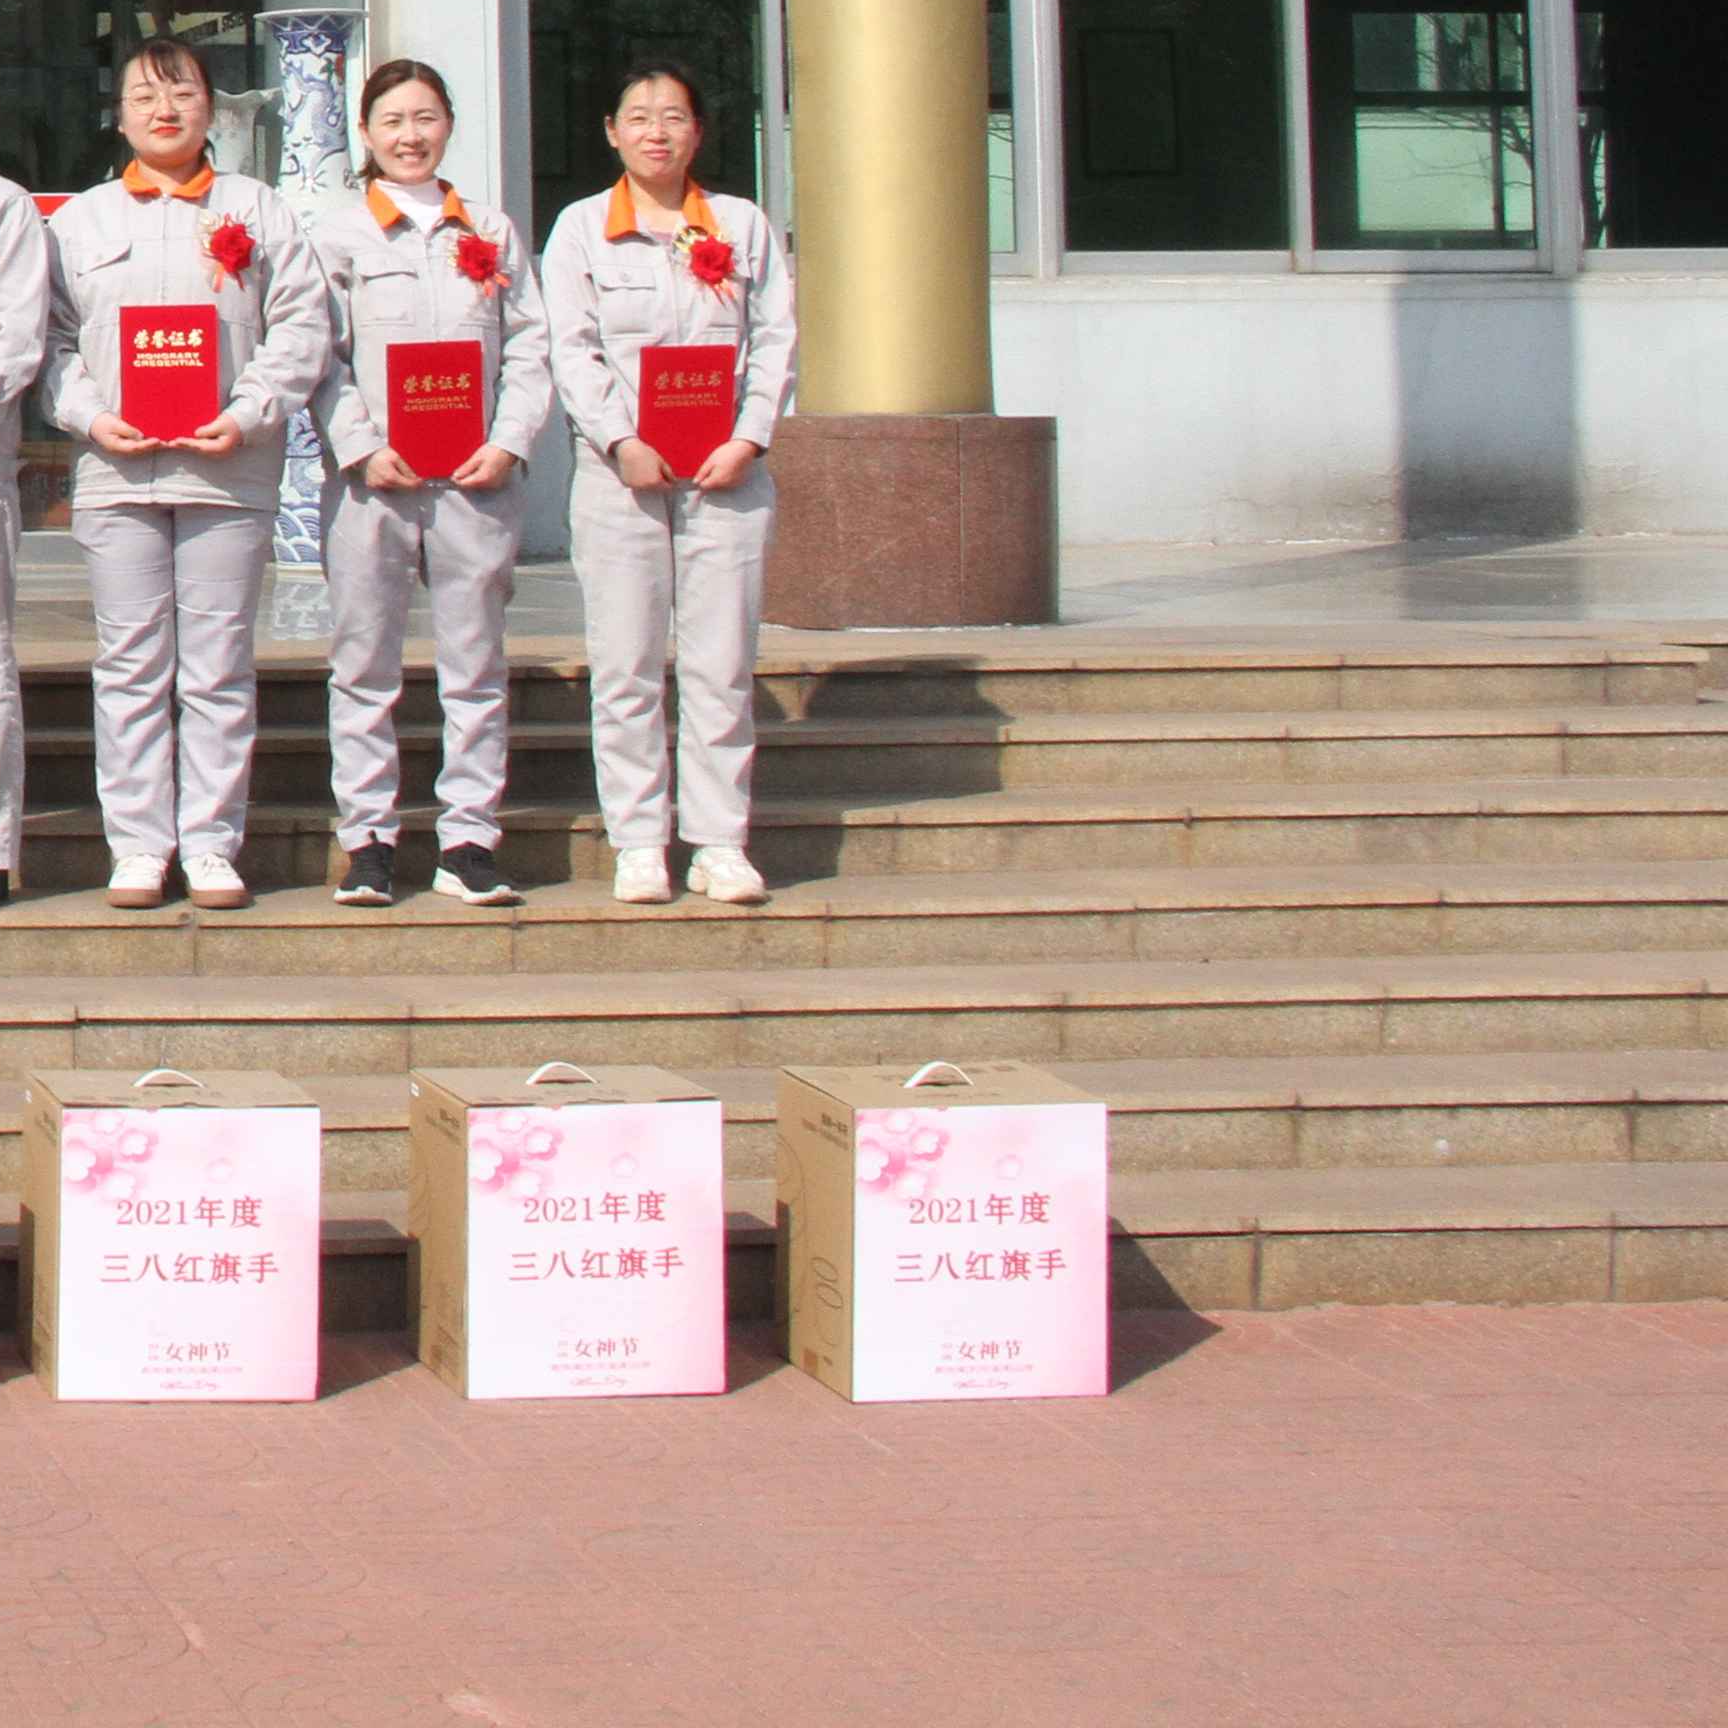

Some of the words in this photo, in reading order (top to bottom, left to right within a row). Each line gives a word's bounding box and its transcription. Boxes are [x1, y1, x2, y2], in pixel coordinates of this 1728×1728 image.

[133, 329, 203, 349] 荣誉证书
[133, 359, 203, 367] CREDENTIAL
[136, 352, 199, 360] HONORARY
[403, 373, 472, 393] 荣誉证书
[655, 370, 723, 390] 荣誉证书
[116, 1194, 263, 1229] 2021年度
[523, 1189, 667, 1224] 2021年度
[908, 1191, 1051, 1225] 2021年度
[101, 1251, 279, 1285] 三八红旗手
[509, 1246, 684, 1281] 三八红旗手
[895, 1248, 1067, 1283] 三八红旗手
[165, 1341, 231, 1362] 女神节
[575, 1338, 639, 1361] 女神节
[958, 1339, 1023, 1361] 女神节
